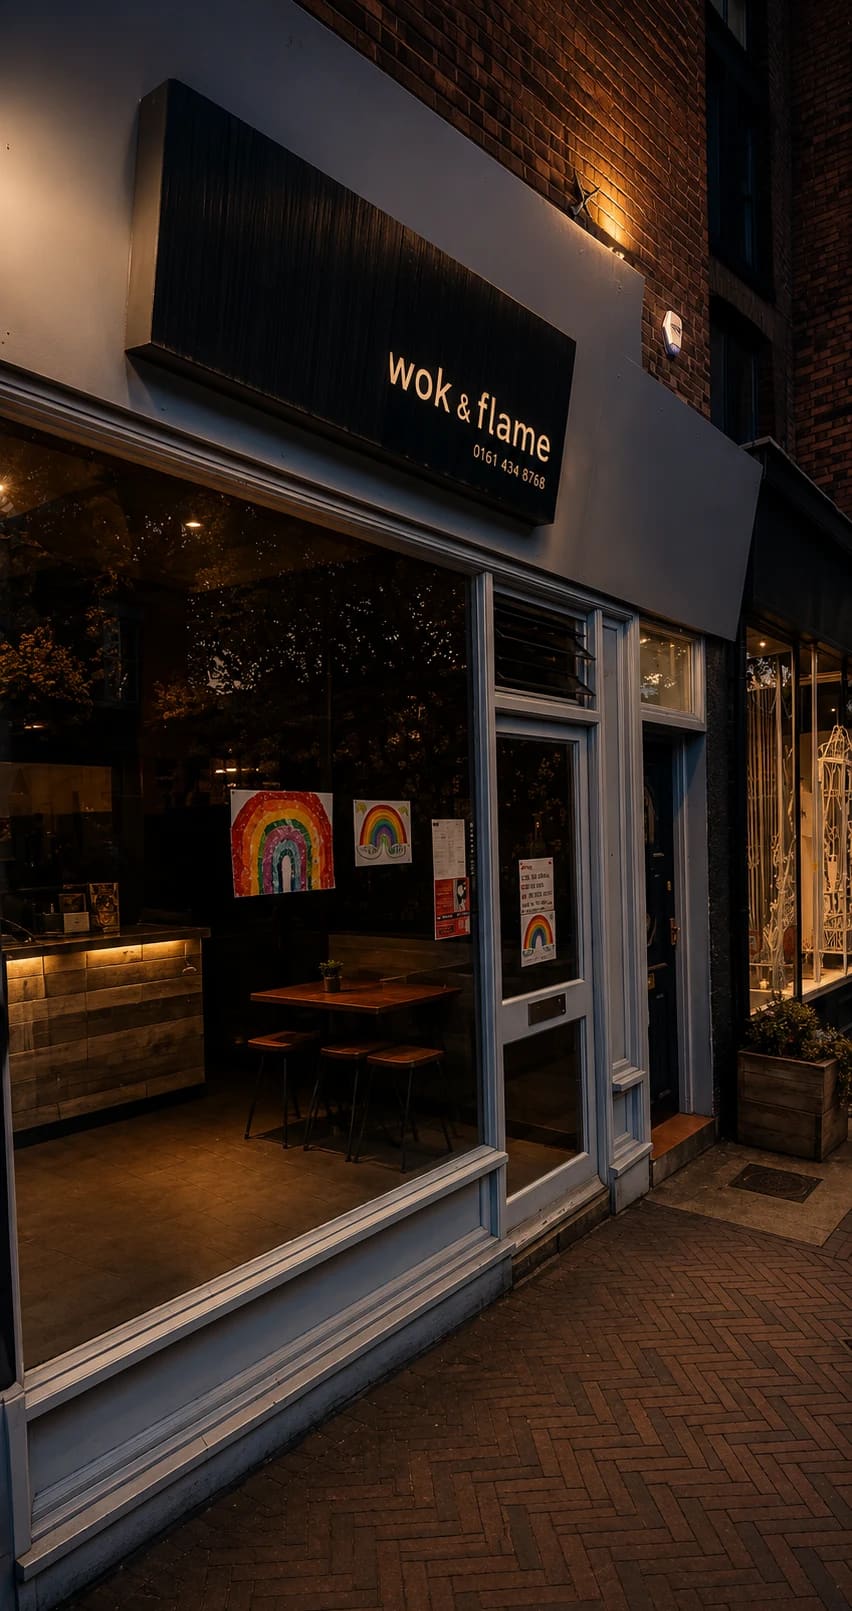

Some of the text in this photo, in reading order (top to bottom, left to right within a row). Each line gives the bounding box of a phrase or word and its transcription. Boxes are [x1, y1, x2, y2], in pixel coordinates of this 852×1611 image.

[389, 351, 551, 462] wok & flame
[473, 444, 546, 490] 0161 434 8768
